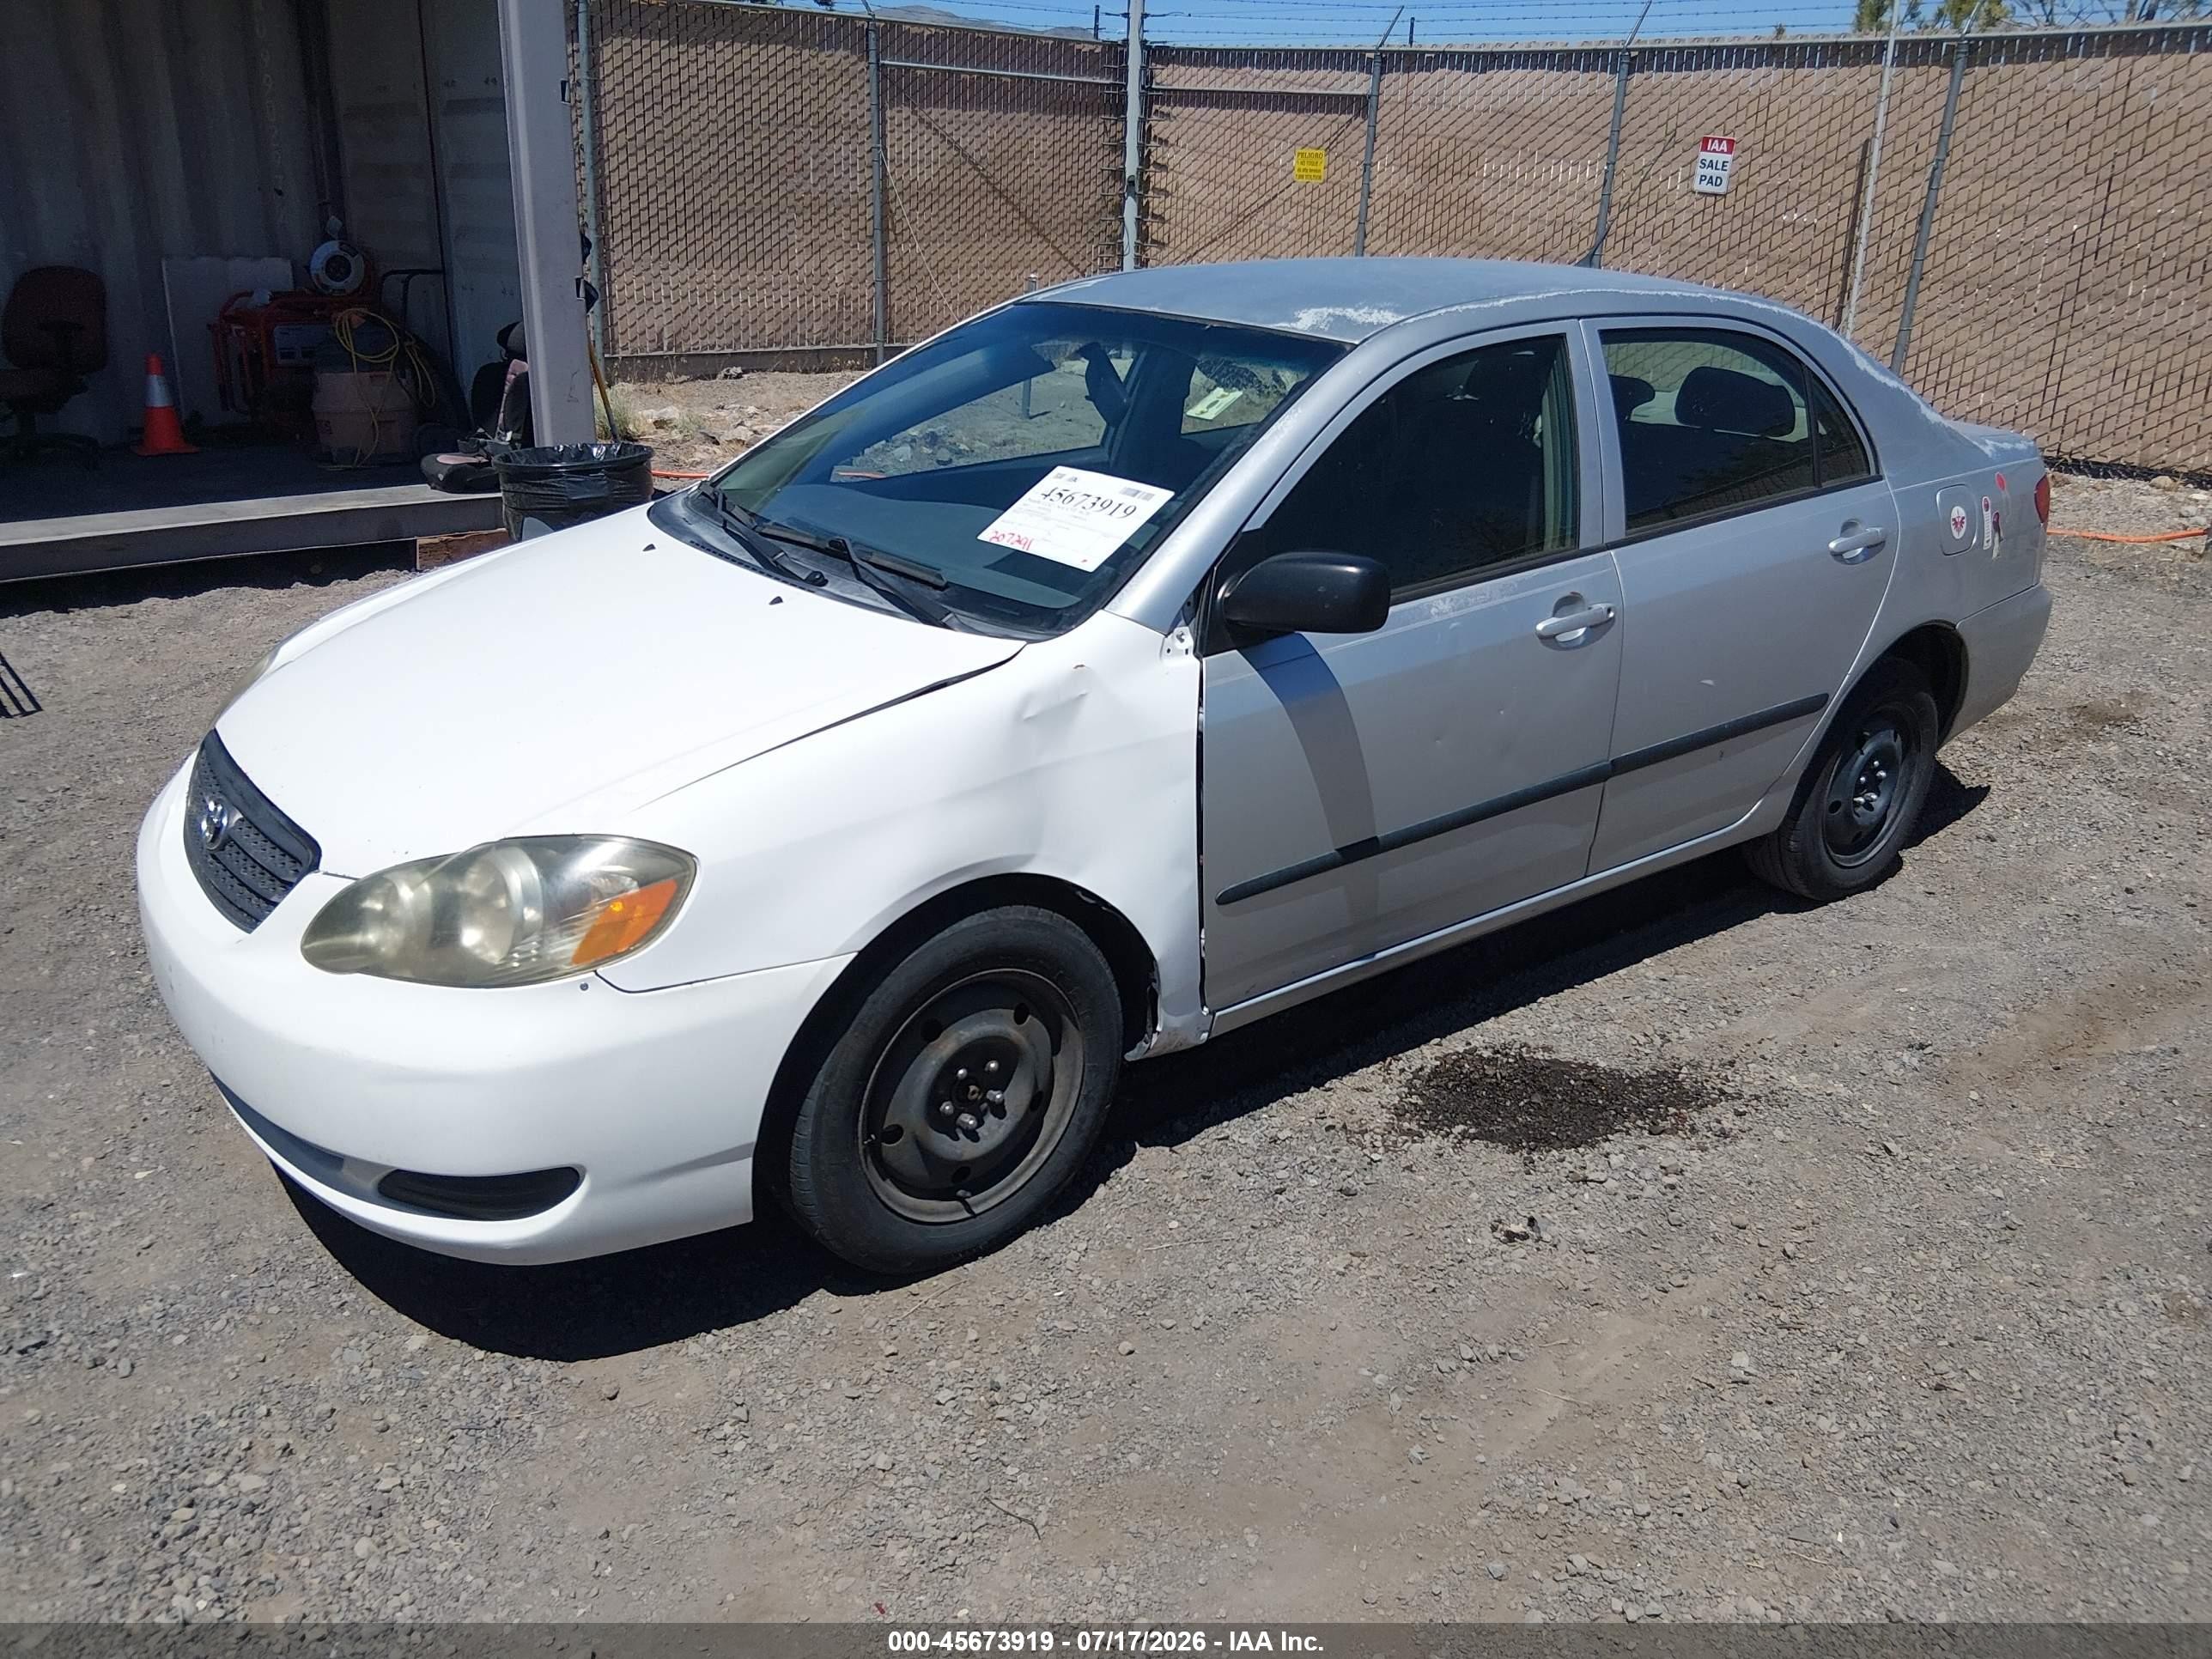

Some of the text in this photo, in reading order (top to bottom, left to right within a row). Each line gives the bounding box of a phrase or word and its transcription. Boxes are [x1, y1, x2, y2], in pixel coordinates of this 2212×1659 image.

[1707, 138, 1728, 152] IAA
[1698, 158, 1729, 172] SALE
[1698, 174, 1723, 187] PAD
[1041, 487, 1138, 519] 45673919
